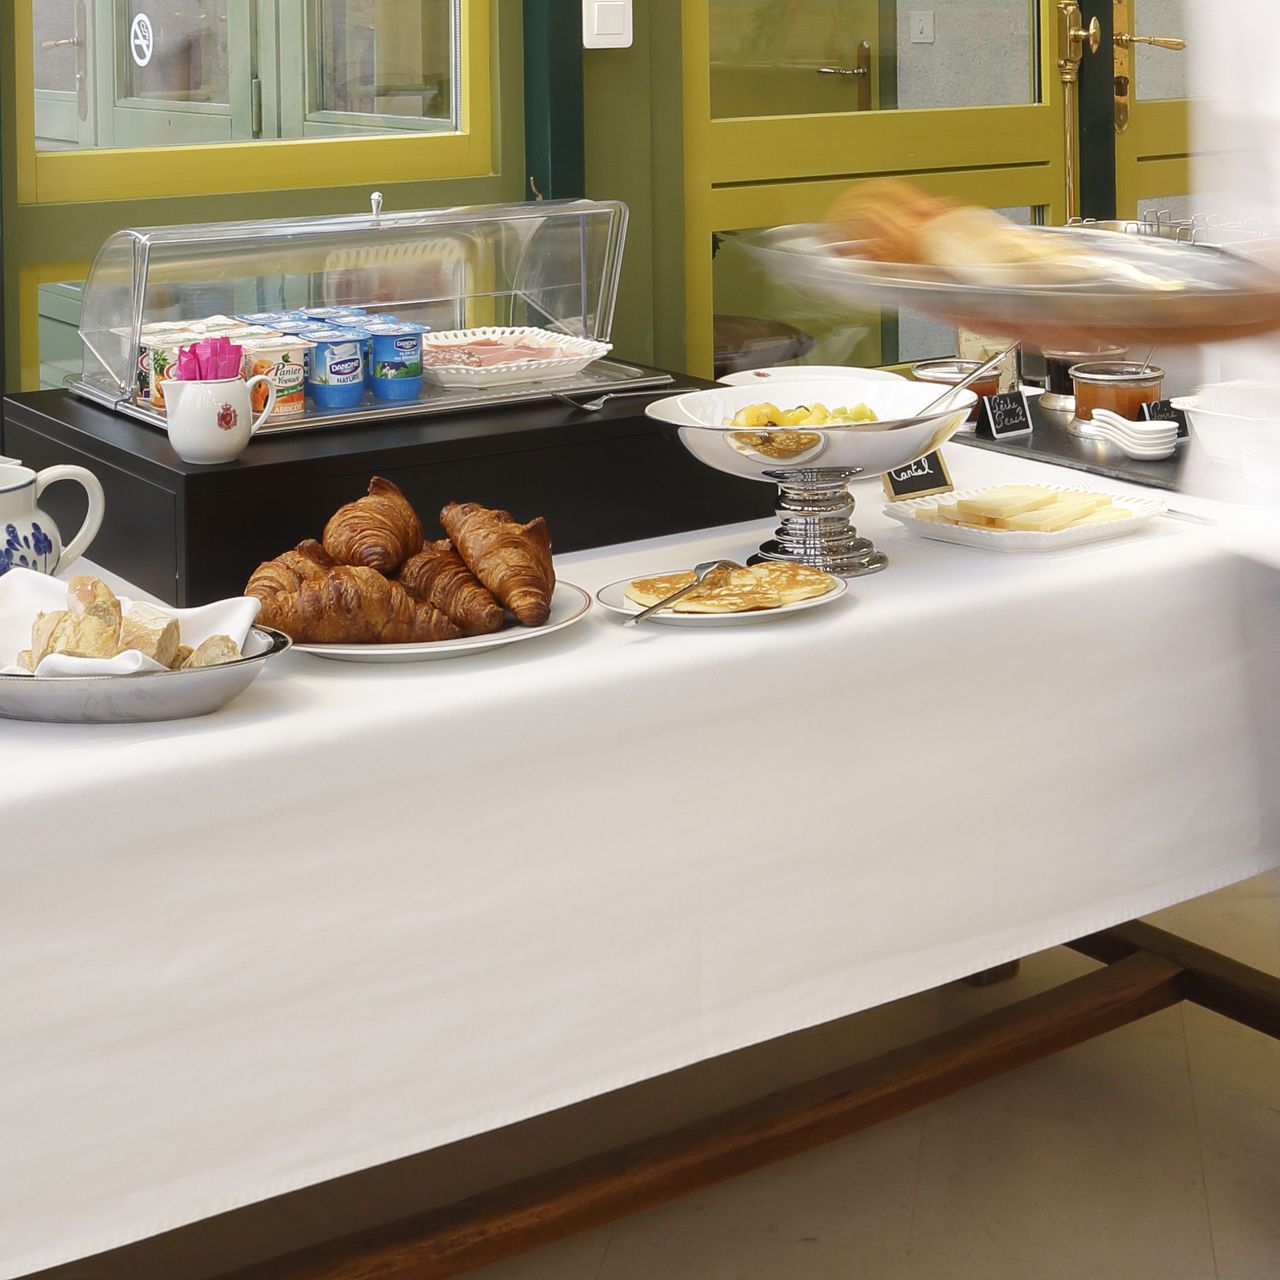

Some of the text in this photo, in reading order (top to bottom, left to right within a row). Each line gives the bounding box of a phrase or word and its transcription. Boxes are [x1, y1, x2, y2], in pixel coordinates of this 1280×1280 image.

[272, 363, 301, 377] Panier
[331, 359, 359, 372] DANONE
[274, 403, 302, 413] ABRICOT
